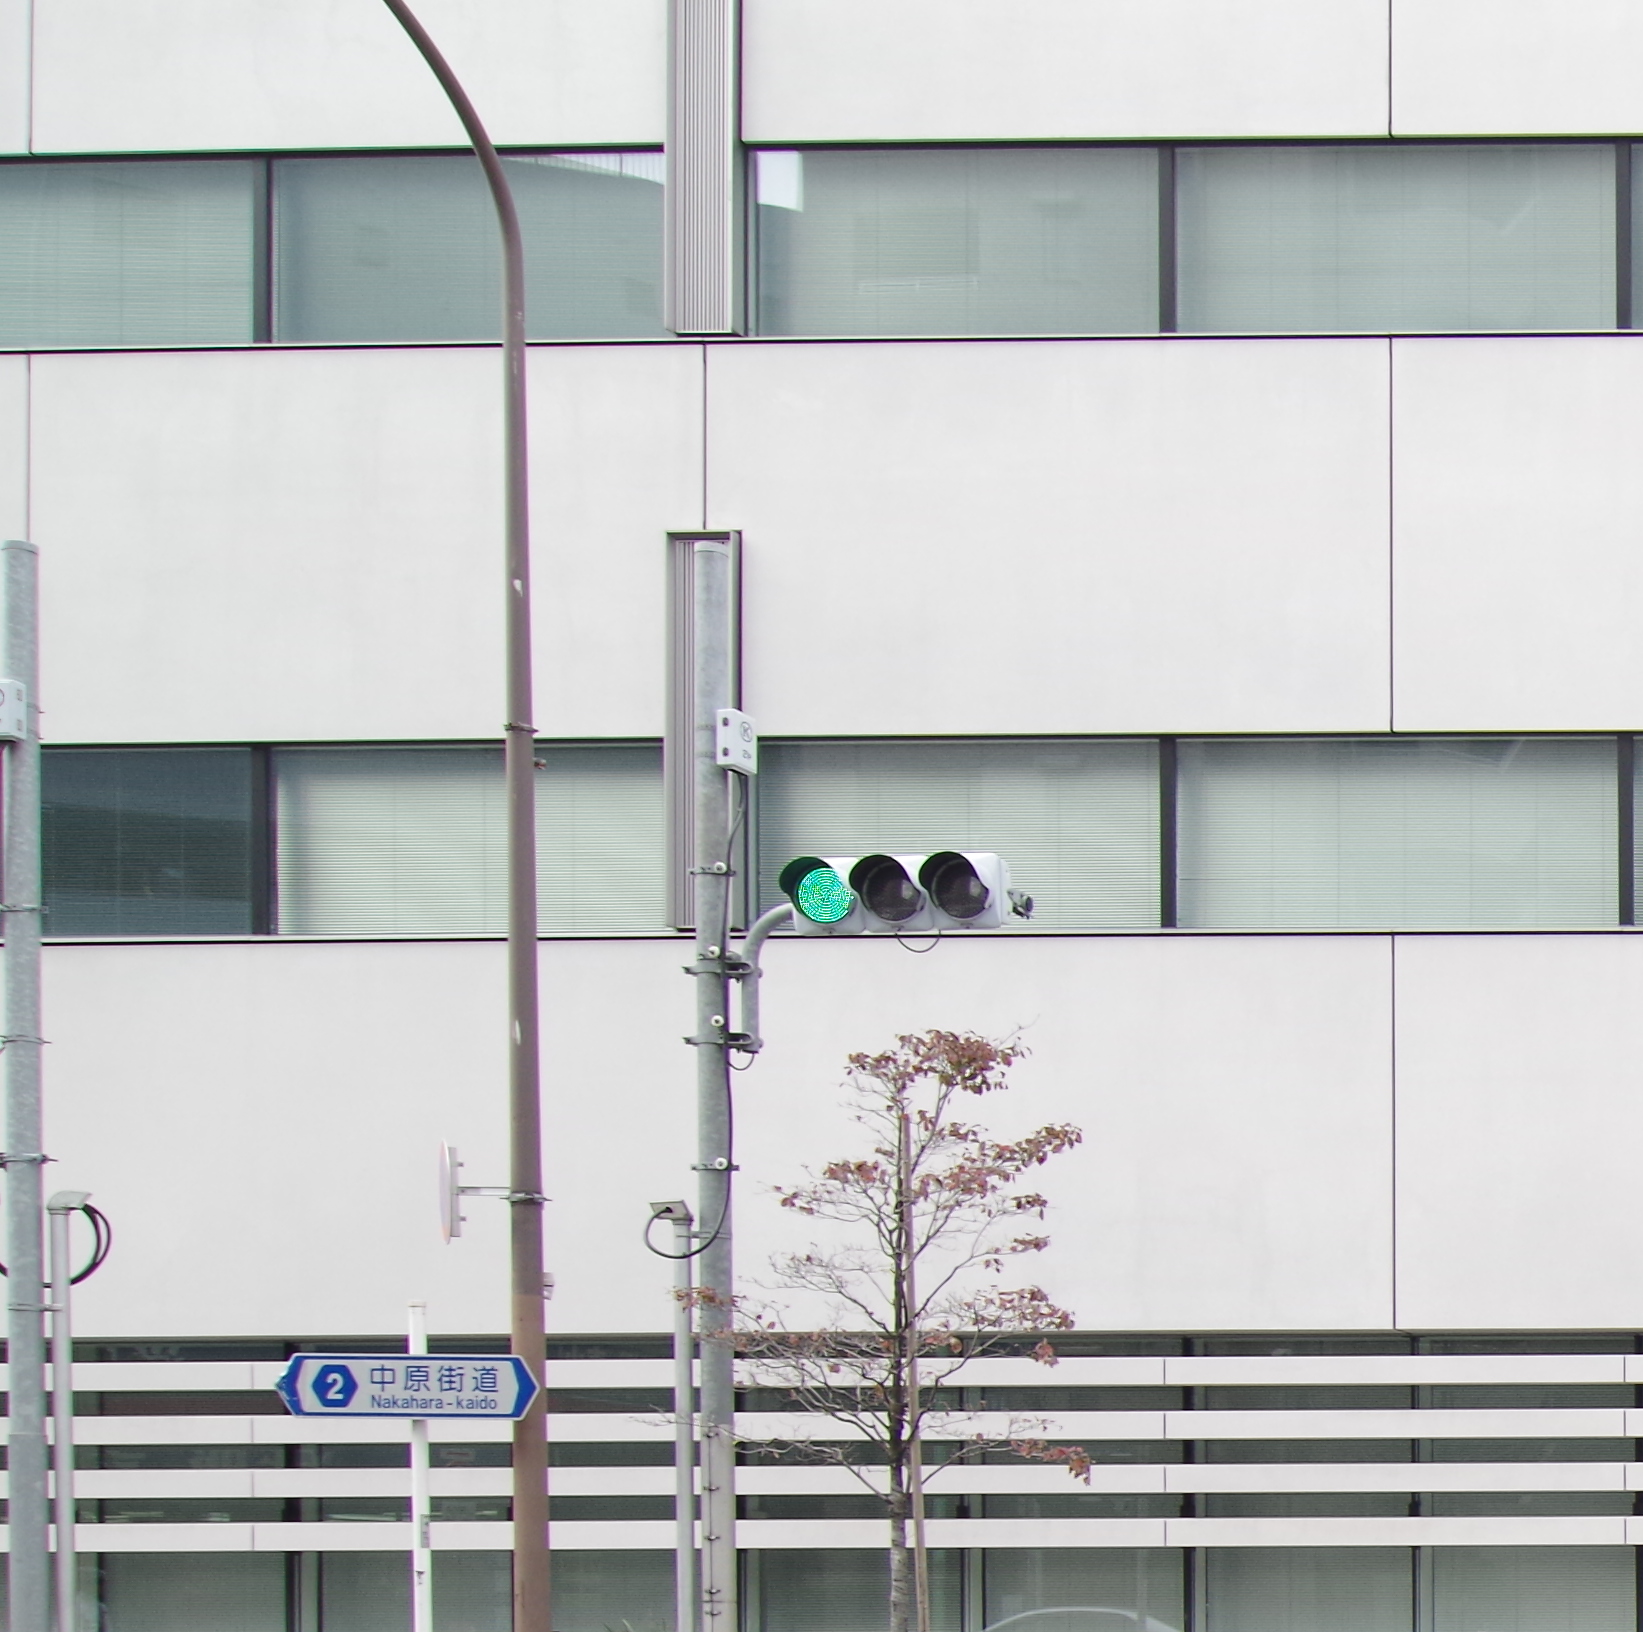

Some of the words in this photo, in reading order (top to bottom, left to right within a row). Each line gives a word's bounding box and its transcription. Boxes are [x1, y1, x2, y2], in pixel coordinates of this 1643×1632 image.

[325, 1373, 344, 1400] 2
[370, 1364, 499, 1393] 中原街道
[371, 1395, 498, 1410] Nakahara-kaido
